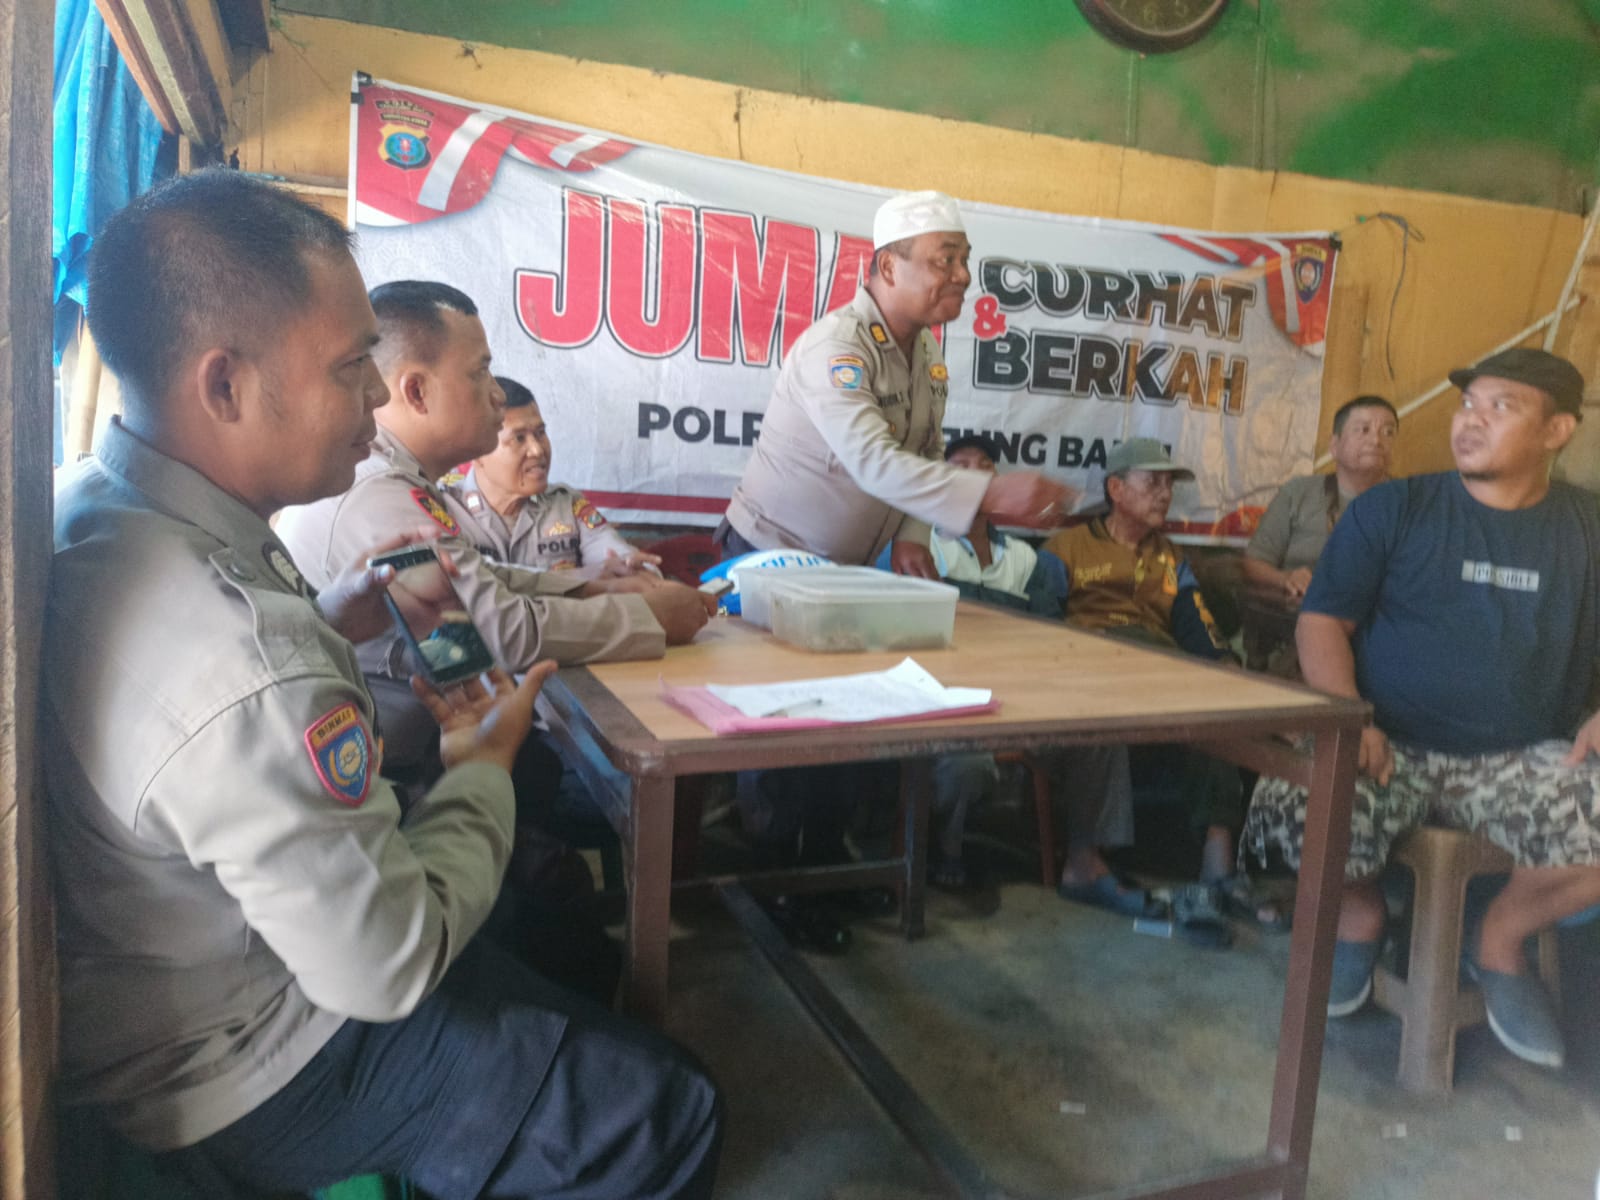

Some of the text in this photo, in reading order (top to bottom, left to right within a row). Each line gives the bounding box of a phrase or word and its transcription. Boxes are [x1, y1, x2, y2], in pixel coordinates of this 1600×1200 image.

[514, 186, 946, 368] JUMA
[972, 294, 1007, 341] &
[979, 256, 1257, 341] CURHAT
[972, 326, 1250, 416] BERKAH
[637, 402, 765, 447] POLR
